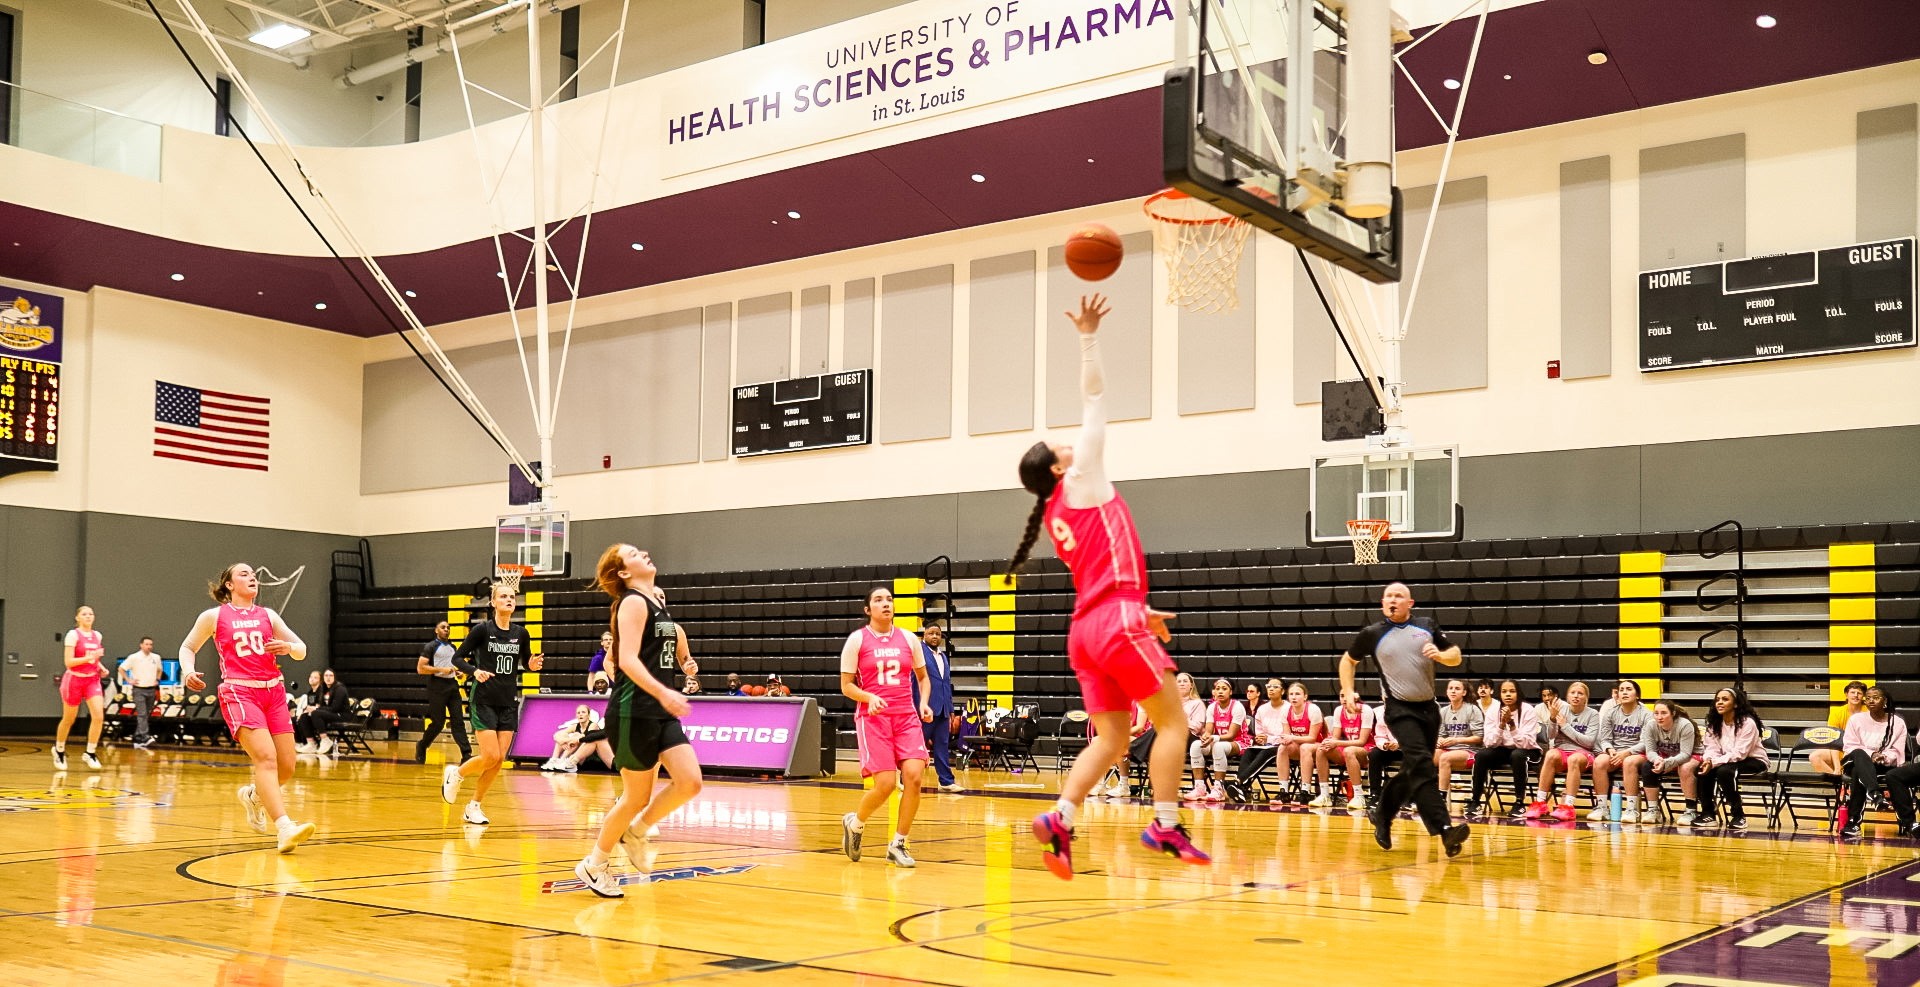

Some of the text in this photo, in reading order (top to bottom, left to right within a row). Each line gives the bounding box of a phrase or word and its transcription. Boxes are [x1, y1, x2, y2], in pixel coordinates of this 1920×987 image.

[827, 0, 1019, 69] UNIVERSITY OF
[669, 91, 781, 145] HEALTH
[793, 47, 954, 113] SCIENCES
[968, 38, 990, 69] &
[872, 85, 965, 121] in St. Louis
[1848, 243, 1904, 265] GUEST
[1649, 270, 1692, 290] HOME
[1745, 298, 1775, 310] PERIOD
[1875, 301, 1903, 312] FOULS
[1825, 307, 1847, 318] T.O.L.
[1743, 312, 1797, 327] PLAYER FOUL
[1647, 326, 1672, 337] FOULS
[1696, 321, 1717, 331] T.O.L.
[1875, 333, 1903, 344] SCORE
[1755, 345, 1784, 356] MATCH
[1647, 356, 1673, 366] SCORE
[36, 363, 56, 375] PTS
[834, 373, 862, 387] GUEST
[737, 386, 759, 399] HOME
[784, 408, 800, 416] PERIOD
[788, 440, 804, 448] MATCH
[846, 434, 861, 442] SCORE
[1052, 517, 1077, 552] 9
[231, 619, 260, 629] UHSP
[232, 631, 266, 658] 20
[873, 648, 900, 657] UHSP
[496, 655, 514, 674] 10
[876, 660, 901, 686] 12
[1445, 723, 1470, 732] UHSP
[1612, 723, 1642, 735] UHSP
